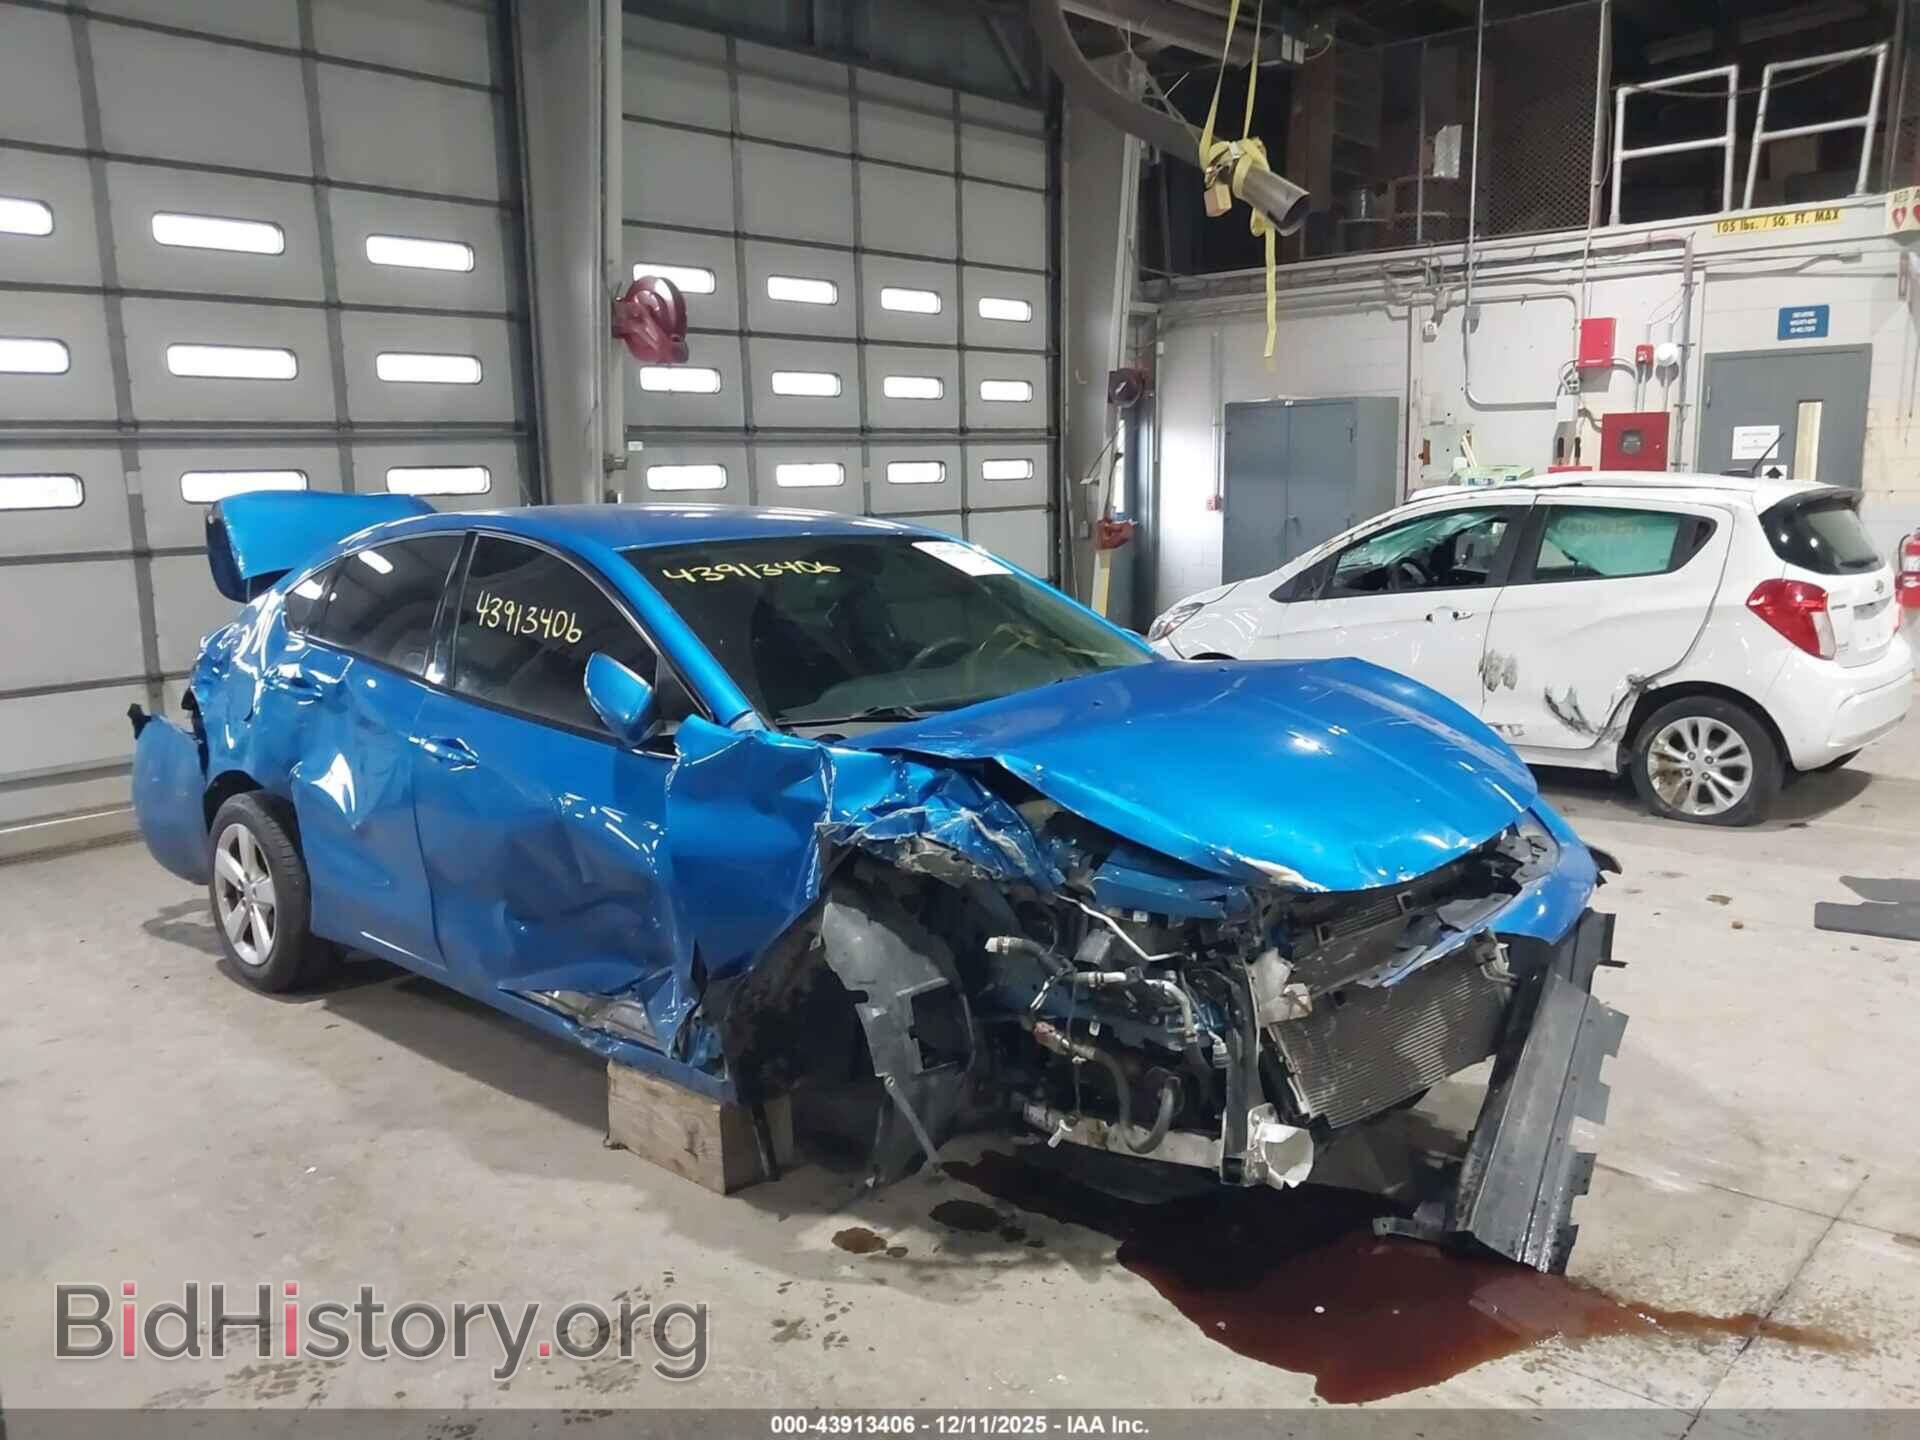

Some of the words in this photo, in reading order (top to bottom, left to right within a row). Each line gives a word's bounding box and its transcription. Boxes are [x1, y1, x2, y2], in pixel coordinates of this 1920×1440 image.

[1717, 222, 1735, 233] 105
[1772, 214, 1789, 227] SQ.
[1795, 212, 1809, 225] FT.
[1814, 209, 1840, 223] MAX
[662, 561, 841, 583] 43913406
[476, 590, 582, 643] 43913406
